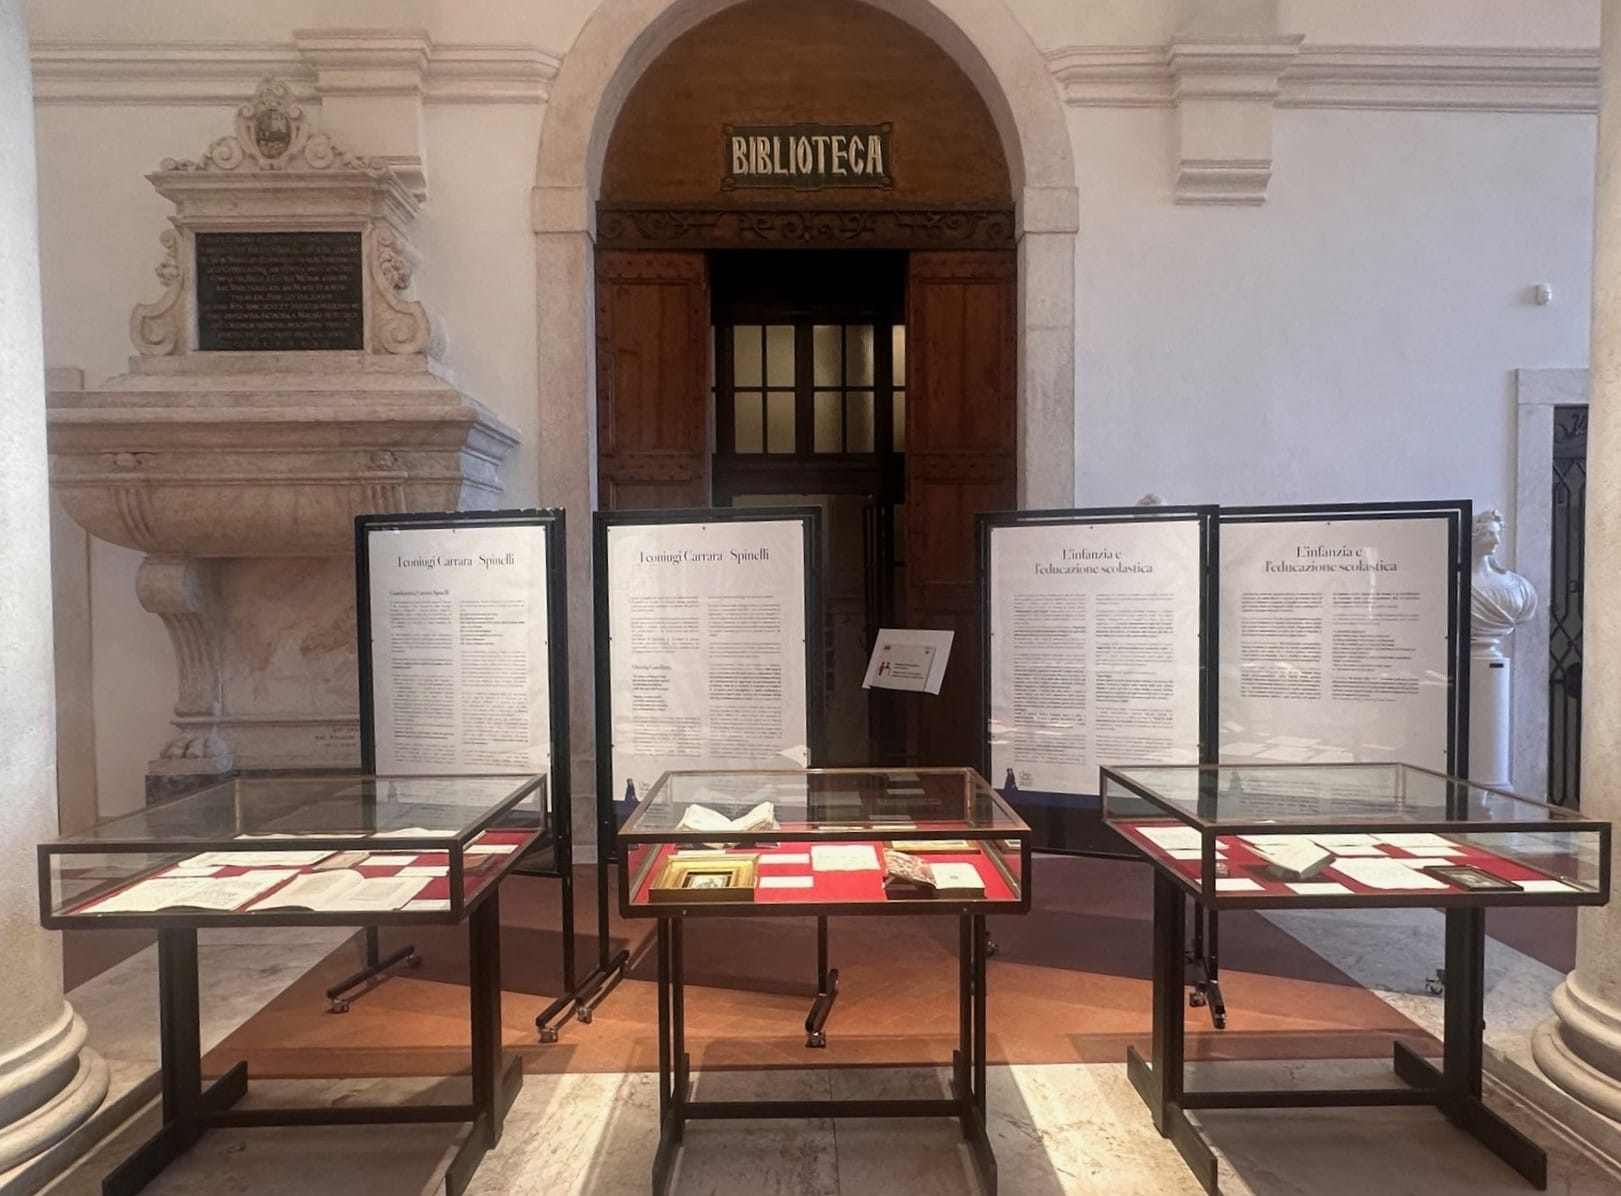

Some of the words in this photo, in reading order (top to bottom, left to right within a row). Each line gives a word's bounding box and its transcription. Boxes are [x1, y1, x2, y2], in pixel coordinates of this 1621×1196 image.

[731, 135, 884, 176] BIBLIOTECA
[646, 550, 682, 565] coniugi
[683, 550, 723, 562] Carrara
[729, 548, 769, 565] Spinelli
[1062, 548, 1113, 561] L'infanzia
[1115, 552, 1121, 560] e
[1296, 545, 1353, 558] L'infanzia
[1355, 549, 1362, 557] e
[402, 555, 436, 570] coniugi
[437, 555, 473, 567] Carrara
[479, 553, 515, 570] Spinelli
[1035, 562, 1099, 575] l'educazione
[1100, 561, 1153, 574] scolastica
[1265, 560, 1337, 573] l'educazione
[1338, 559, 1398, 572] scolastica
